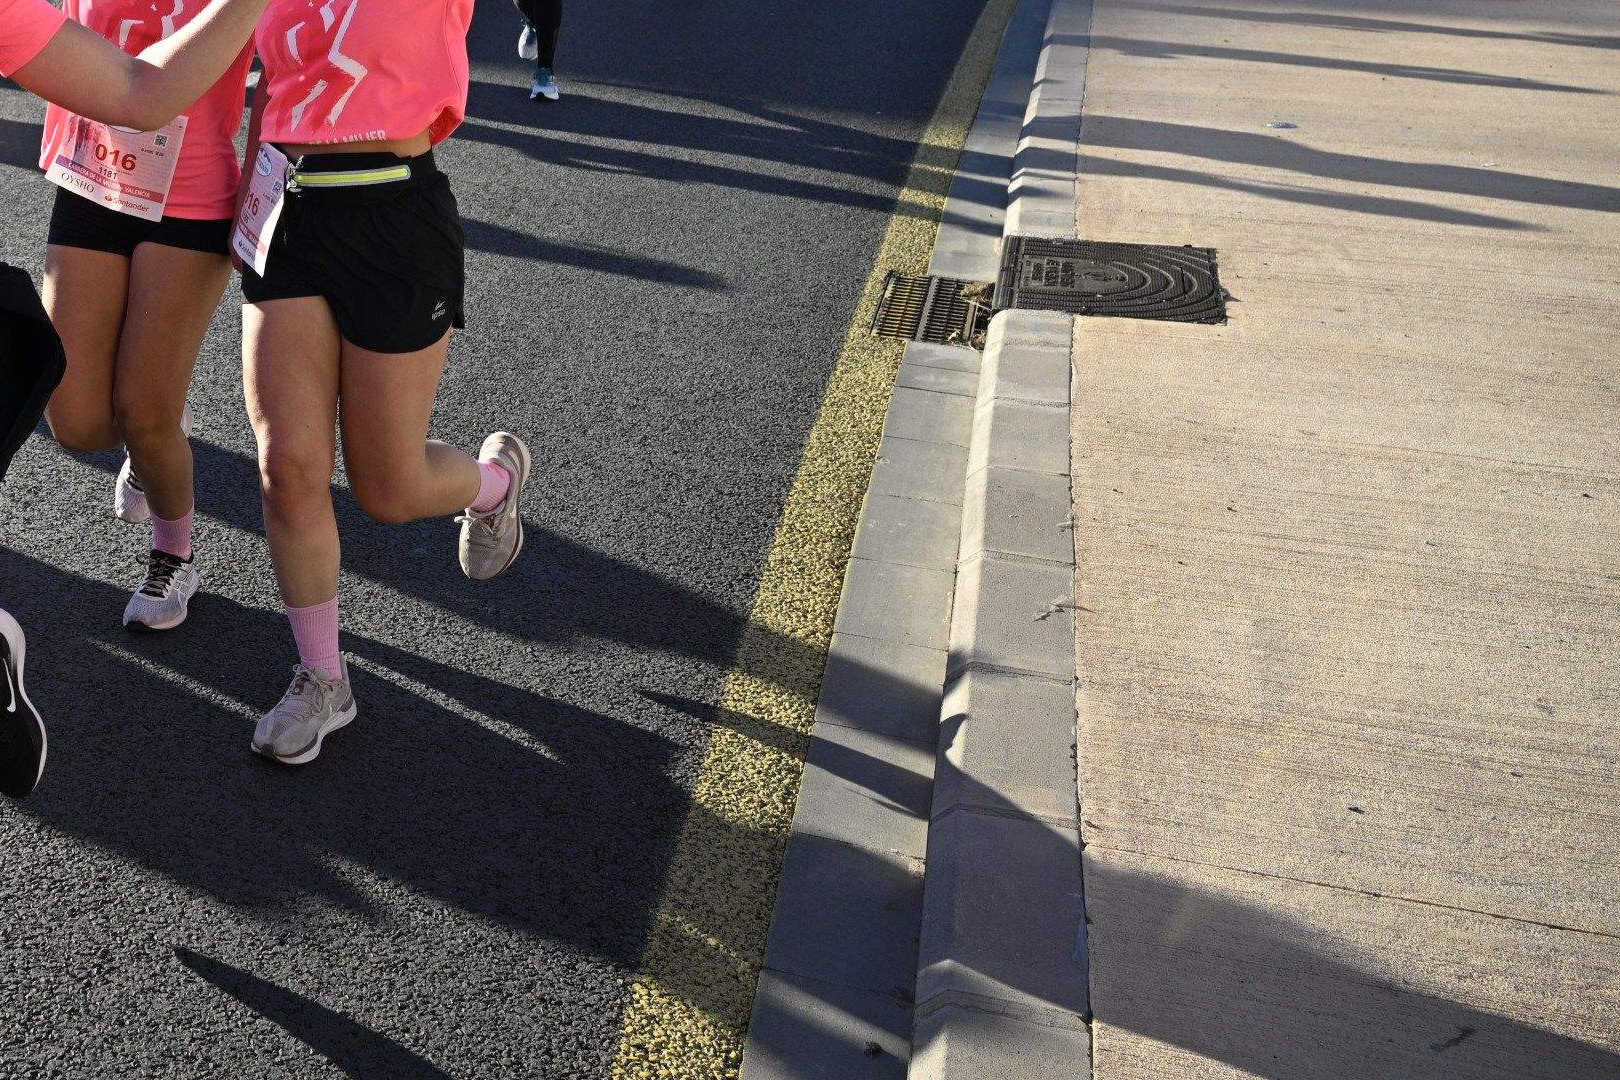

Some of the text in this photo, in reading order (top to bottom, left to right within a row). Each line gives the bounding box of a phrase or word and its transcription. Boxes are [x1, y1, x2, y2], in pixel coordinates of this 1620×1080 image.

[95, 143, 138, 171] 016
[60, 171, 96, 194] OYSHO
[98, 166, 118, 180] 1181
[113, 196, 149, 213] Santander
